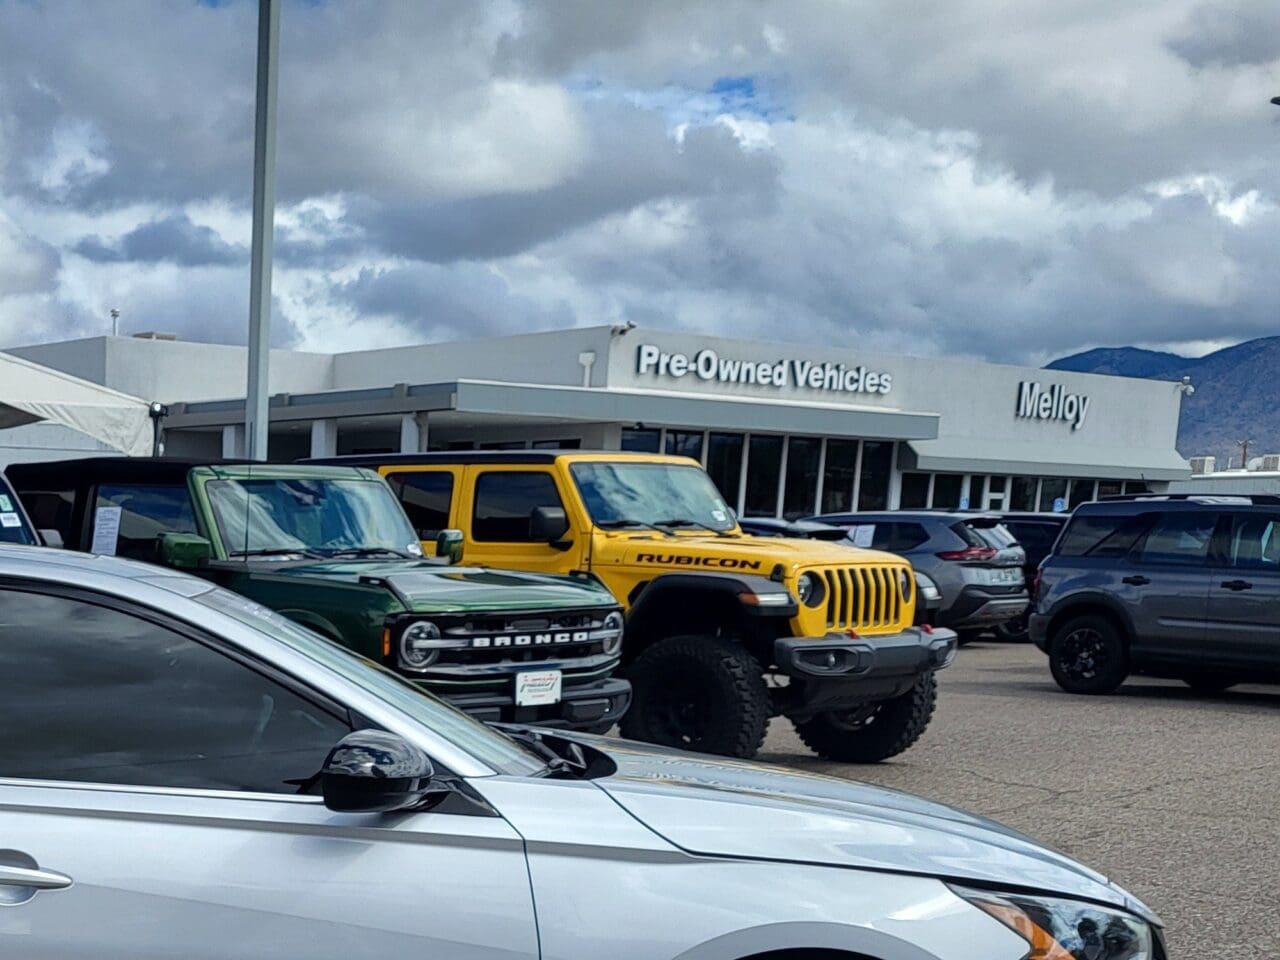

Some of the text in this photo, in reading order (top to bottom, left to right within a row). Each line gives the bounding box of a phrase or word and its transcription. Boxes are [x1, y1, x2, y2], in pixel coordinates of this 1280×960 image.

[638, 344, 893, 394] Pre-Owned Vehicles
[1018, 381, 1090, 430] Melloy
[636, 553, 762, 570] RUBICON
[472, 631, 589, 648] BRONCO
